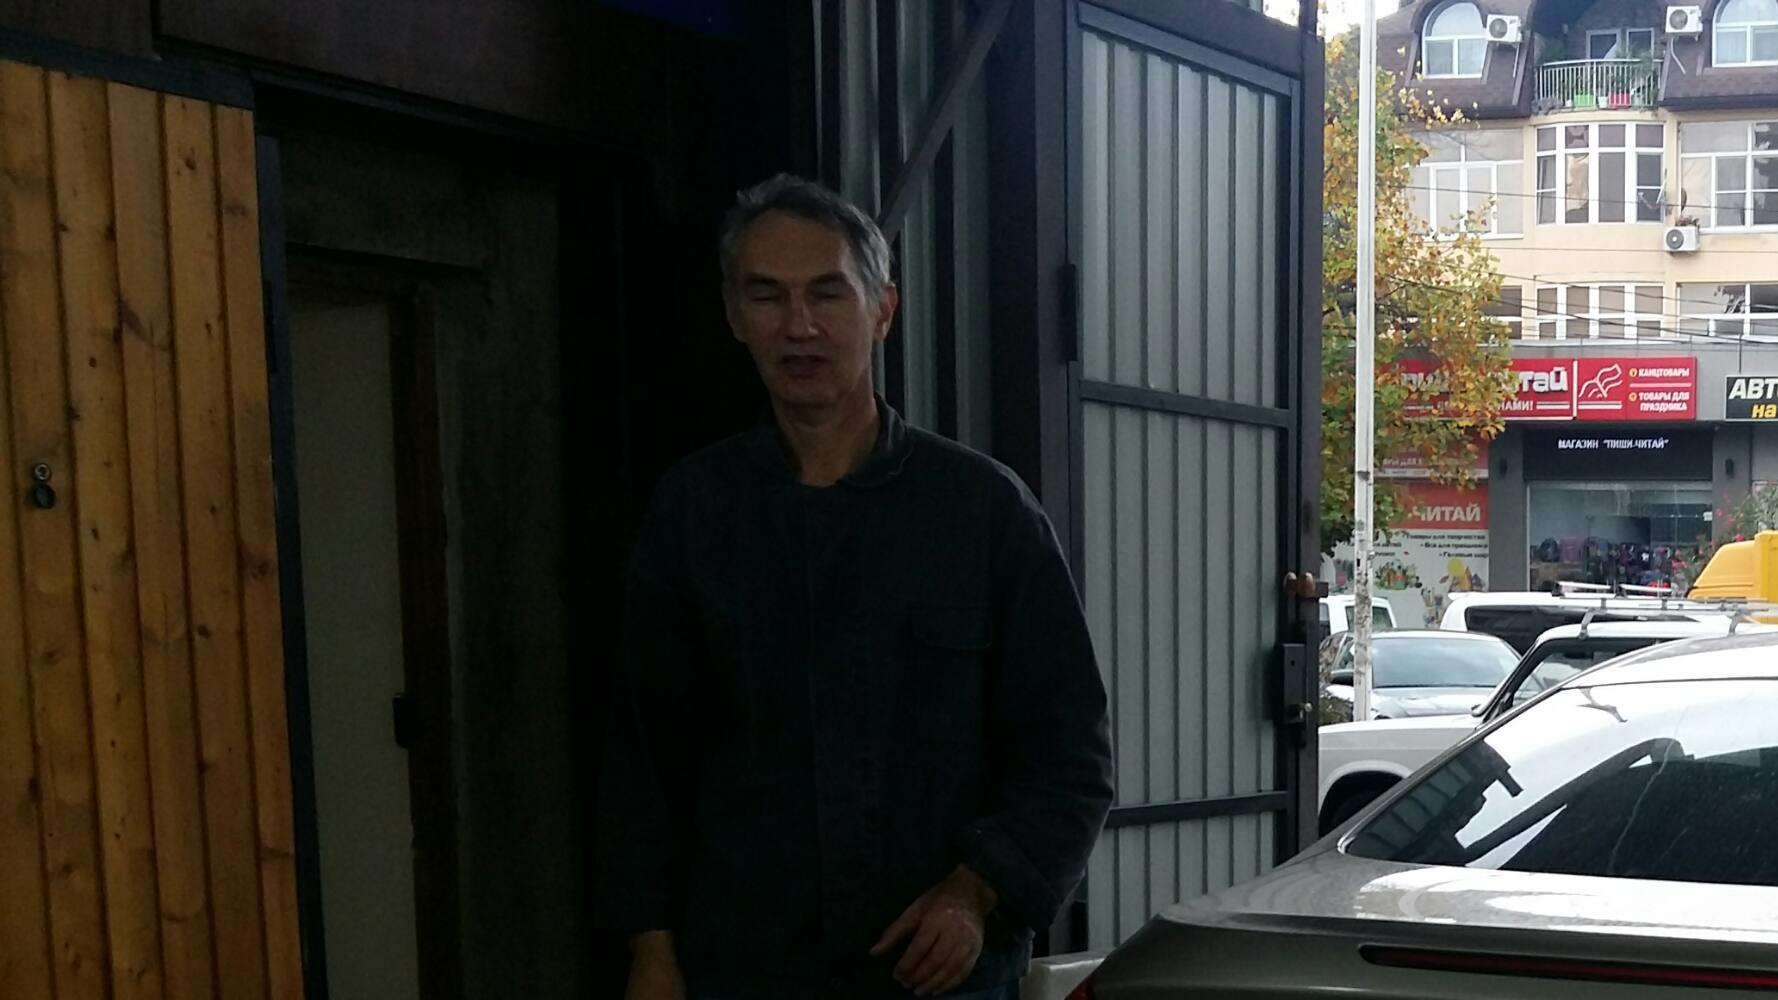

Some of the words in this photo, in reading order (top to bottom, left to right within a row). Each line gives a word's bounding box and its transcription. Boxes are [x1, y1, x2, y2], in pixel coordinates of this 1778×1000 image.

[1638, 368, 1690, 378] КАНЦТОВАРЫ
[1638, 391, 1671, 401] ТОВАРЫ
[1672, 391, 1690, 401] ДЛЯ
[1640, 403, 1688, 412] ПРАЗДНИКА
[1752, 404, 1777, 418] на
[1558, 439, 1599, 449] МАГАЗИН
